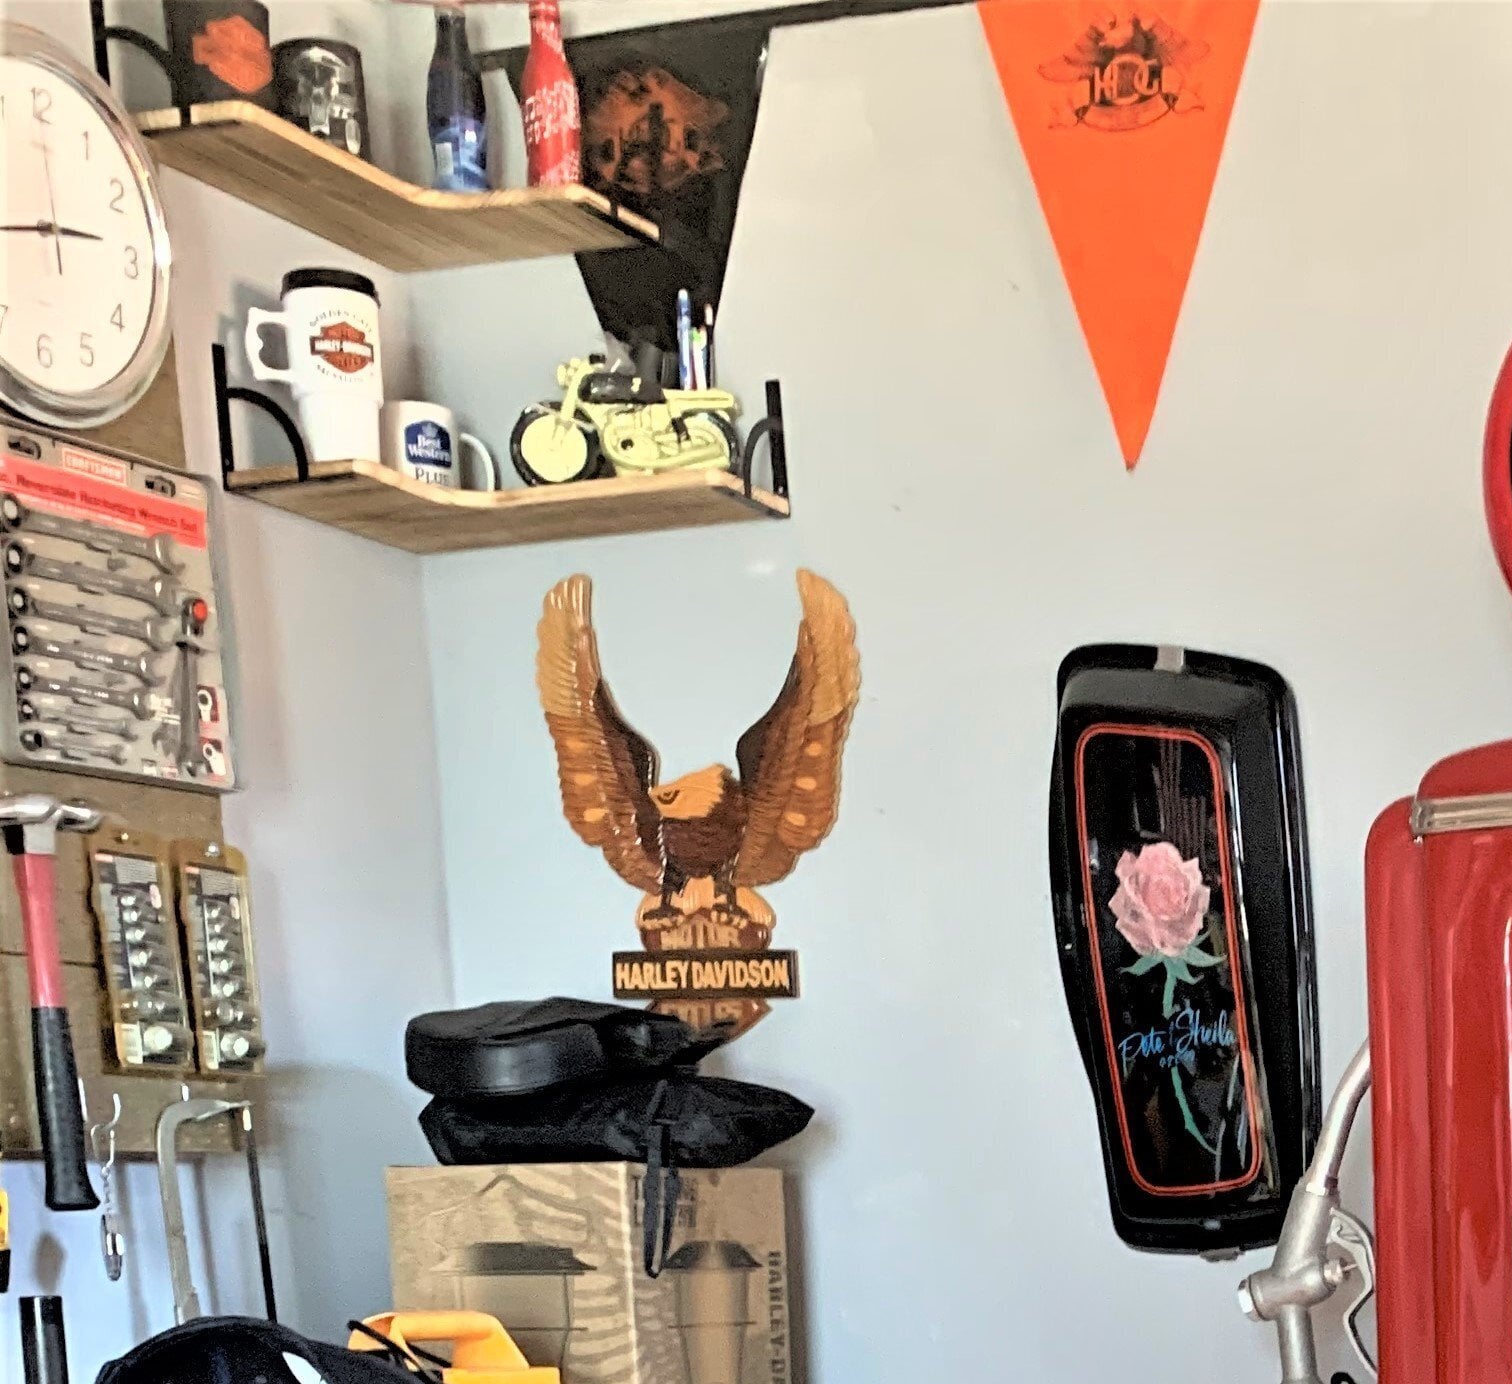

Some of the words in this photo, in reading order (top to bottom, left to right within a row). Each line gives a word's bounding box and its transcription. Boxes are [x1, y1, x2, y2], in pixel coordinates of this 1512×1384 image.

[31, 86, 52, 125] 12
[83, 130, 89, 161] 1
[109, 178, 125, 214] 2
[123, 245, 139, 280] 3
[109, 303, 125, 333] 4
[36, 333, 53, 369] 6
[79, 332, 95, 367] 5
[408, 444, 450, 462] Western
[417, 434, 441, 449] Best
[616, 960, 690, 990] HARLEY
[692, 959, 790, 991] DAVIDSON
